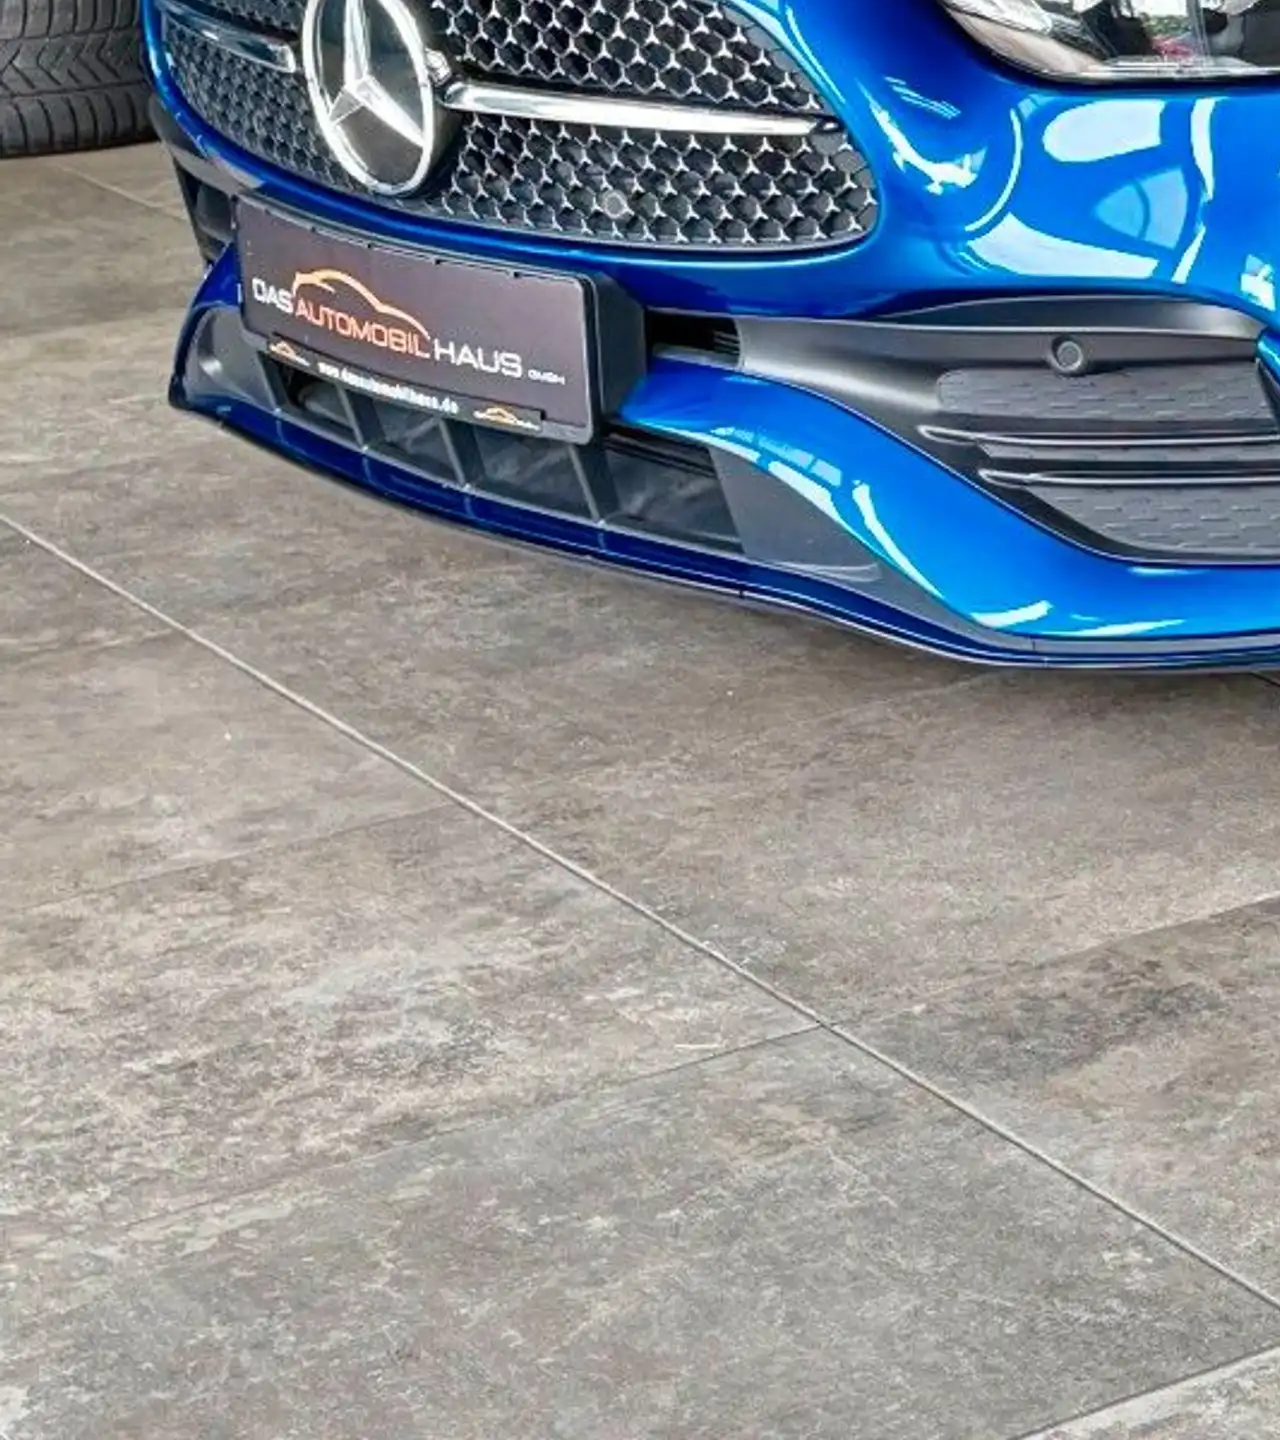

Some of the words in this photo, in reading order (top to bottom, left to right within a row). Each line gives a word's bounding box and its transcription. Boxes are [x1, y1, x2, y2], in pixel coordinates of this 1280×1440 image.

[251, 277, 294, 314] DAS
[294, 297, 431, 359] AUTOMOBIL
[433, 338, 523, 379] HAUS
